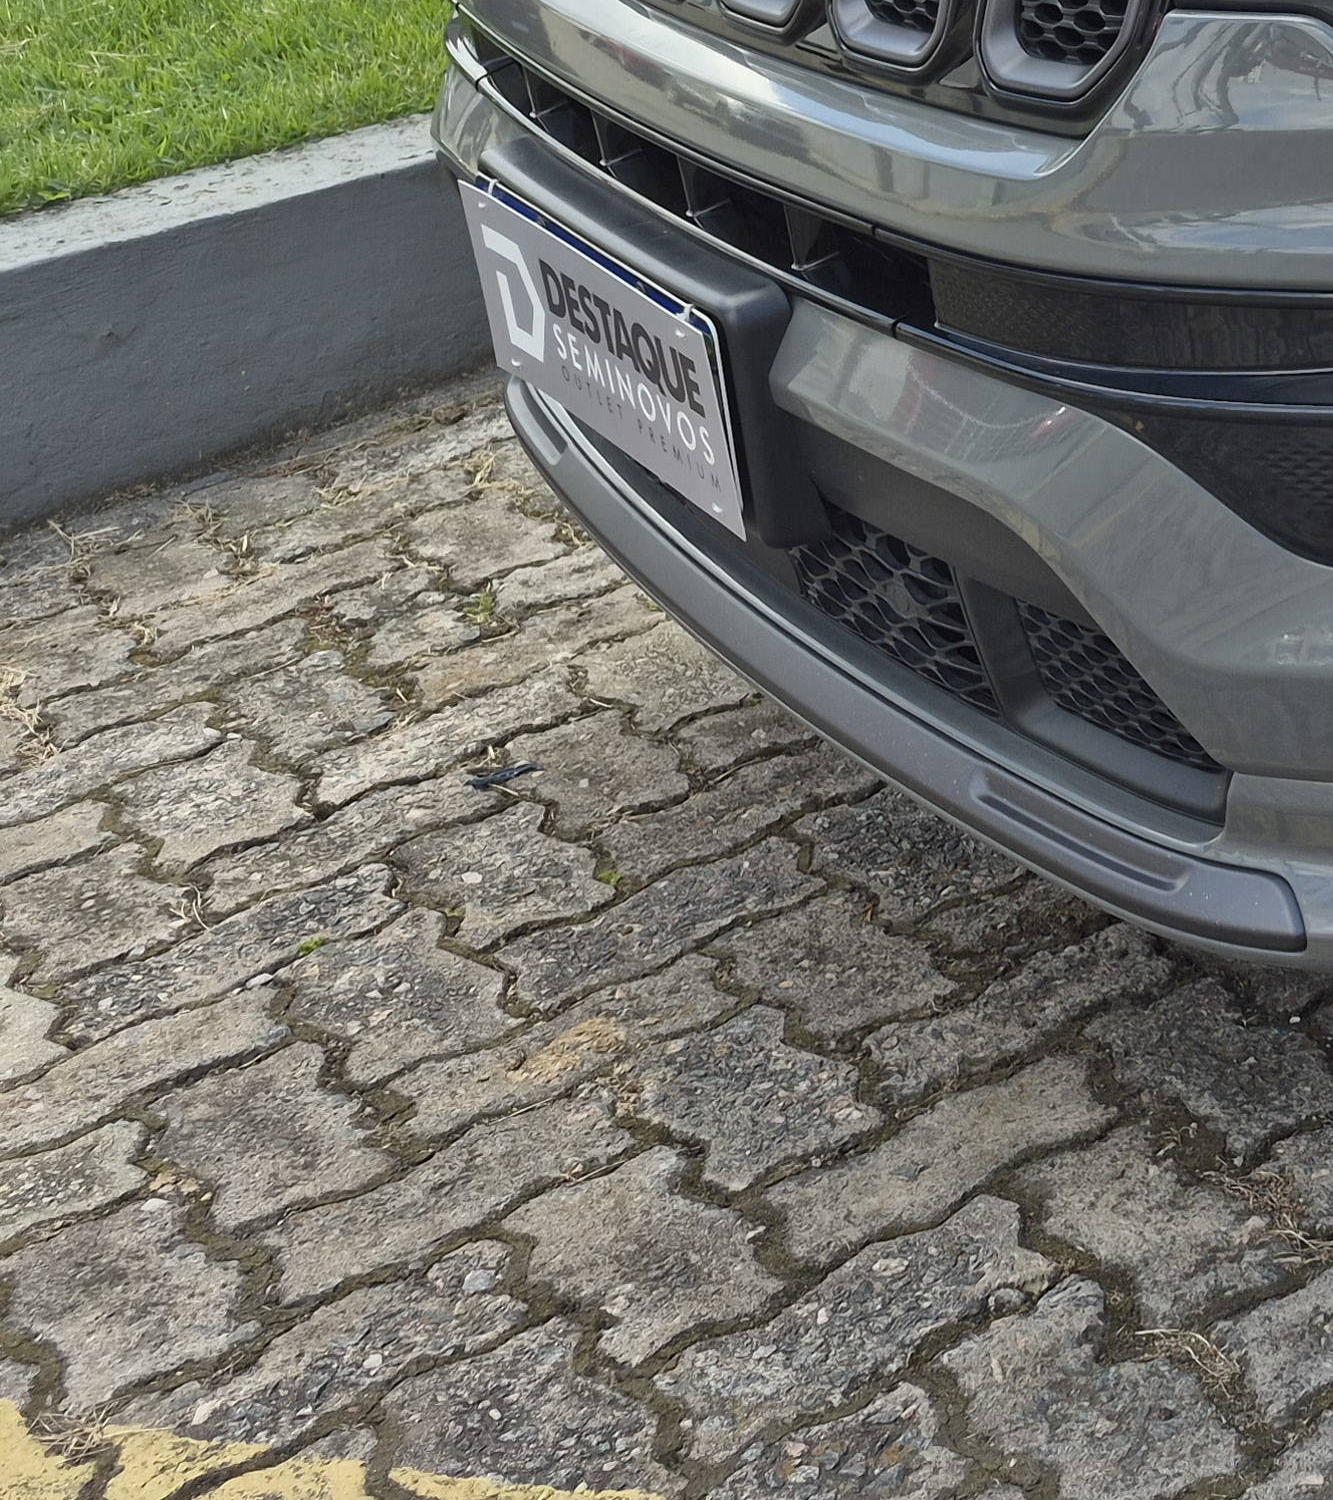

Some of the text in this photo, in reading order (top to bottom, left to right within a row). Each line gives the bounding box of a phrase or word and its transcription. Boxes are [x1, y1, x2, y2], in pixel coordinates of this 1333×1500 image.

[538, 257, 706, 419] DESTAQUE
[552, 322, 715, 466] SEMINOVOS
[561, 364, 723, 493] OUTLET PREMIUM
